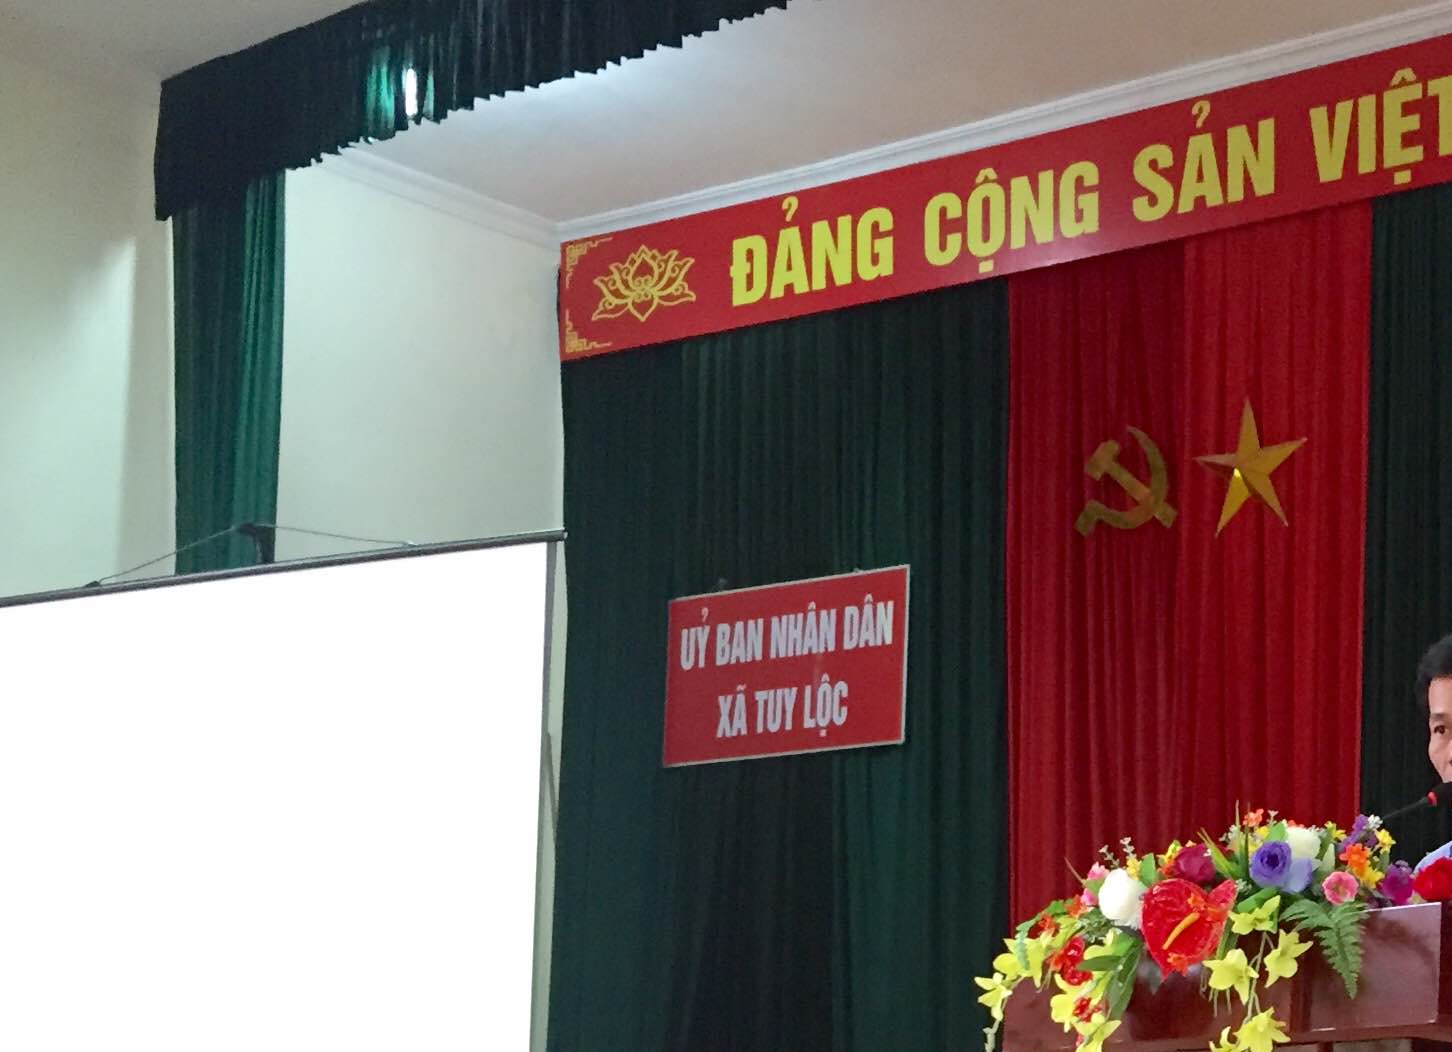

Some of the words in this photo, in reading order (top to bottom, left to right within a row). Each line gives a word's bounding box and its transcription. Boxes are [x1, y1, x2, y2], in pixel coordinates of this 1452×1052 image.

[730, 197, 894, 307] ĐẢNG
[924, 167, 1100, 274] CỘNG
[1132, 102, 1275, 222] SẢN
[681, 608, 710, 670] UỶ
[716, 618, 763, 666] BAN
[770, 602, 836, 659] NHÂN
[843, 594, 894, 650] DÂN
[716, 684, 748, 738] XÃ
[755, 687, 797, 733] TUY
[803, 672, 849, 737] LỘC
